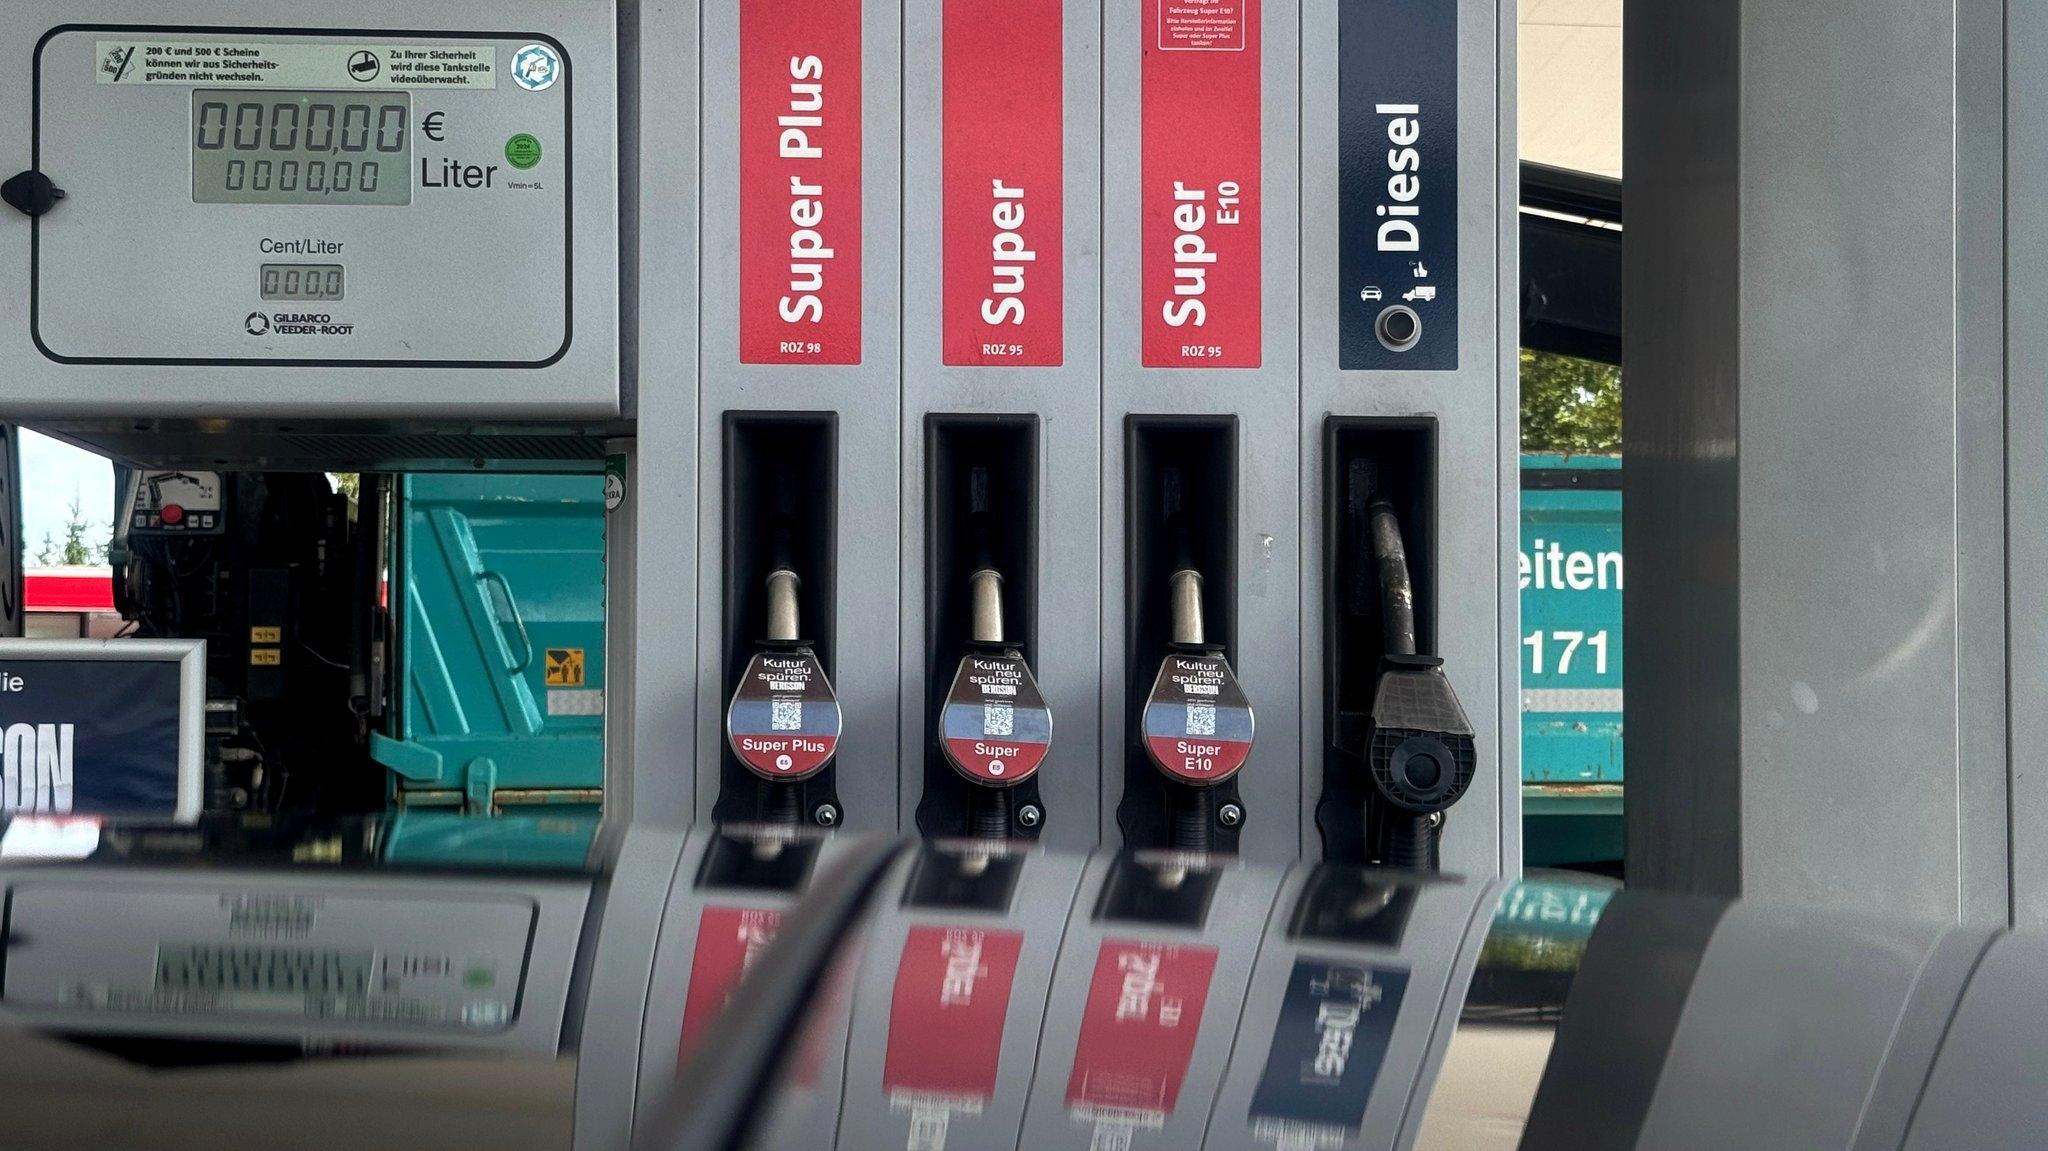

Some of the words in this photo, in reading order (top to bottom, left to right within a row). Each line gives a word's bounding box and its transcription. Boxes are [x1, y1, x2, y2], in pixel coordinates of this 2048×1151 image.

[146, 46, 163, 55] 200
[165, 47, 173, 55] €
[174, 47, 192, 55] und
[195, 47, 211, 56] 500
[214, 48, 221, 56] €
[223, 48, 260, 57] Scheine
[390, 50, 402, 59] Zu
[404, 50, 427, 59] Ihrer
[429, 51, 476, 60] Sicherheit
[145, 59, 182, 68] können
[184, 60, 200, 68] wir
[222, 60, 280, 69] Sicherheits-
[390, 63, 412, 71] wird
[414, 63, 440, 71] diese
[442, 63, 490, 72] Tankstelle
[145, 71, 187, 81] gründen
[189, 72, 214, 80] nicht
[215, 72, 264, 81] wechseln.
[390, 75, 470, 84] videoüberwacht.
[777, 55, 824, 159] Plus
[421, 111, 446, 142] €
[421, 157, 498, 189] Liter
[1375, 103, 1420, 252] Diesel
[1216, 180, 1240, 225] E10
[260, 238, 344, 255] Cent/Liter
[778, 175, 835, 324] Super
[981, 178, 1036, 326] Super
[1162, 181, 1217, 328] Super
[273, 313, 331, 323] GILBARCO
[273, 325, 354, 335] VEEDER-ROOT
[780, 341, 804, 354] ROZ
[806, 342, 821, 354] 98
[982, 343, 1006, 356] ROZ
[1008, 344, 1023, 356] 95
[1181, 345, 1205, 358] ROZ
[1207, 346, 1222, 358] 95
[1523, 630, 1607, 674] 171
[763, 658, 806, 668] Kultur
[974, 660, 1015, 671] Kultur
[1176, 660, 1218, 671] Kultur
[758, 672, 812, 682] spüren.
[784, 667, 811, 675] neu
[995, 670, 1022, 678] neu
[1197, 670, 1224, 678] neu
[969, 675, 1022, 686] spüren.
[1172, 675, 1225, 685] spüren.
[742, 738, 788, 753] Super
[792, 739, 825, 752] Plus
[974, 742, 1020, 759] Super
[1177, 741, 1221, 756] Super
[0, 723, 75, 814] ON
[1185, 757, 1212, 771] E10
